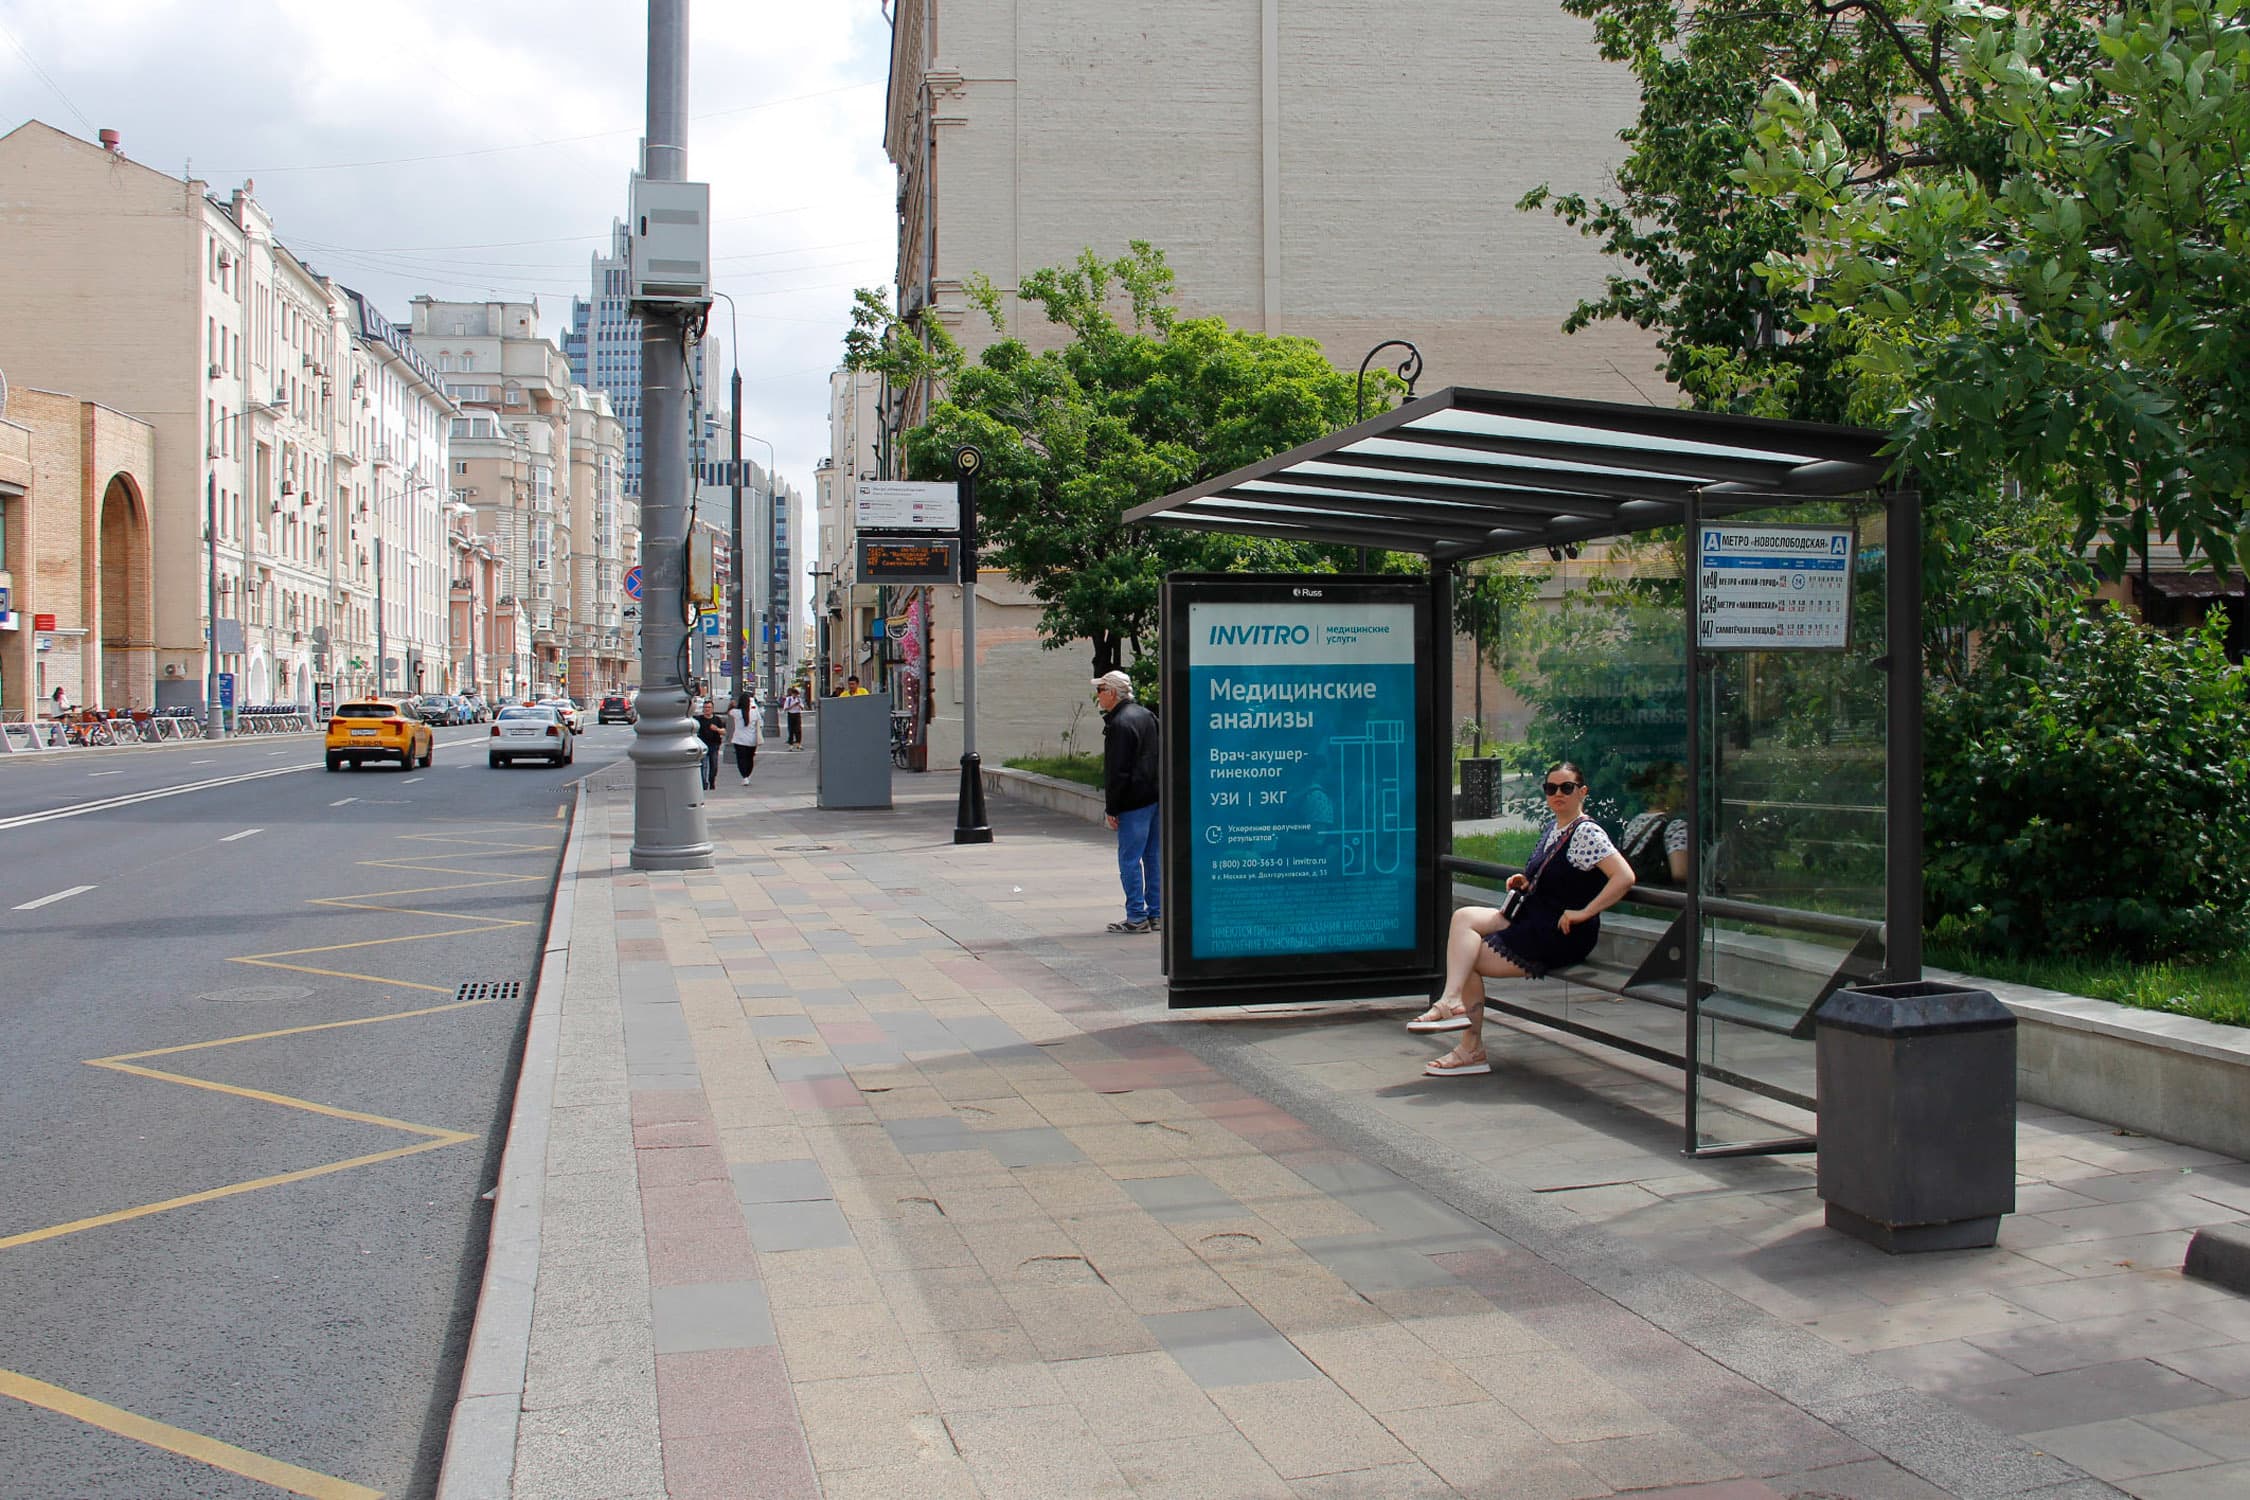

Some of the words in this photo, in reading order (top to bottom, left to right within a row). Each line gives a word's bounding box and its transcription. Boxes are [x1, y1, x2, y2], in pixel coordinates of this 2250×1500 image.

[1722, 535, 1749, 547] МЕТРО
[1751, 537, 1829, 549] «НОВОСЛОБОДСКАЯ»
[1302, 588, 1323, 597] Russ
[1717, 600, 1736, 609] МЕТРО
[1209, 625, 1310, 646] INVITRO
[1326, 625, 1390, 635] медицинские
[1701, 620, 1714, 639] 447
[1326, 636, 1357, 645] услуги
[1210, 678, 1377, 703] Медицинские
[1209, 711, 1314, 730] анализы
[1210, 748, 1309, 766] Врач-акушер-
[1210, 766, 1283, 780] гинеколог
[1210, 792, 1239, 806] УЗИ
[1260, 790, 1287, 804] ЭКГ
[1228, 824, 1271, 834] Ускоренное
[1272, 823, 1312, 833] получение
[1212, 860, 1217, 869] 8
[1219, 859, 1240, 870] (800)
[1293, 857, 1327, 866] invitro.ru
